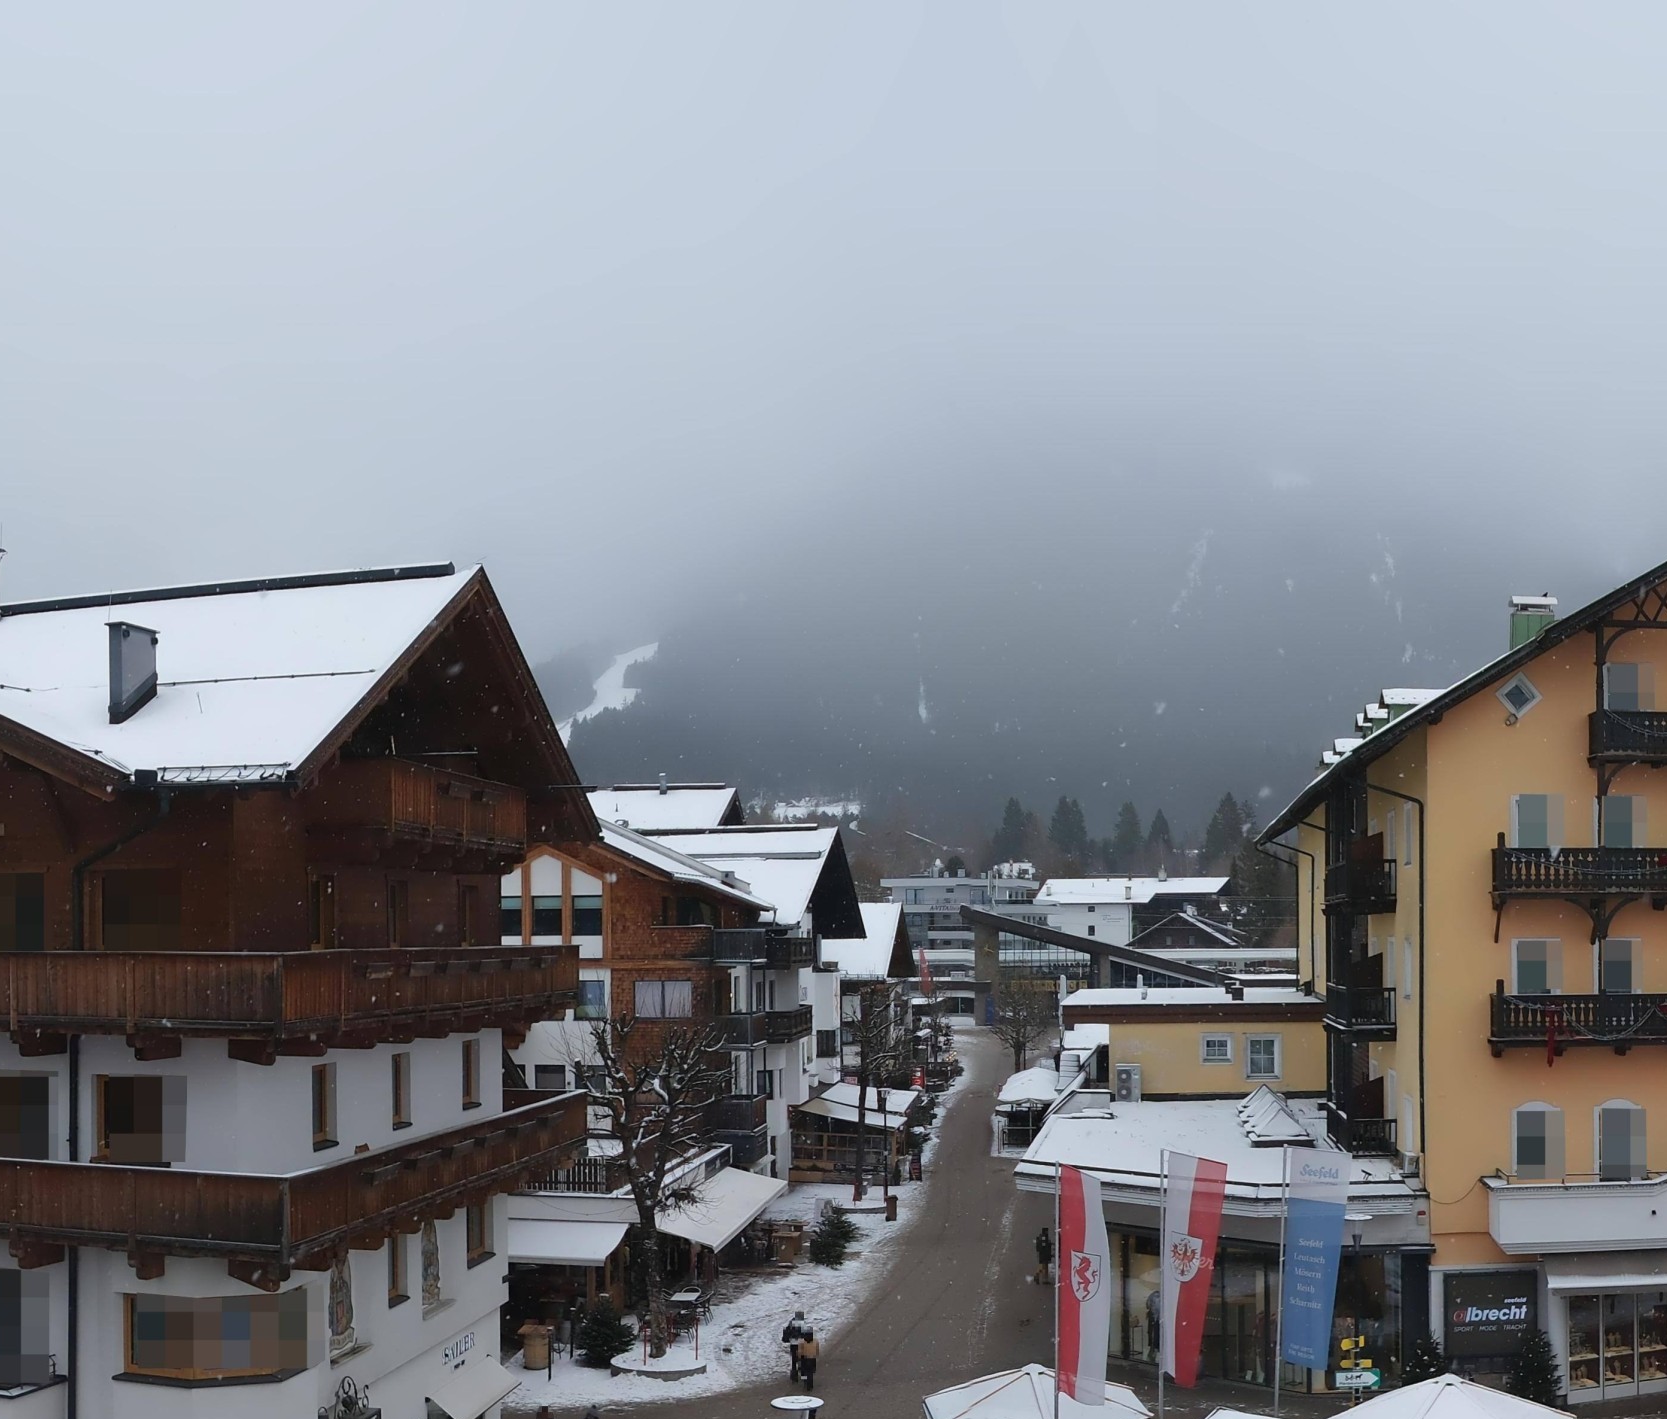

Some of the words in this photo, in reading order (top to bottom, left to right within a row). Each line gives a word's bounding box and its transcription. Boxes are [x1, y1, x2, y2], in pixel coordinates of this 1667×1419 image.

[1300, 1164, 1339, 1179] Seefeld
[1298, 1238, 1324, 1249] Seefeld
[1294, 1252, 1325, 1264] Leutasch
[1295, 1267, 1321, 1279] Mösern
[1297, 1282, 1315, 1294] Reith
[1289, 1296, 1322, 1309] Scharnitz
[1453, 1325, 1474, 1333] SPORT
[1503, 1323, 1527, 1331] TRACHT
